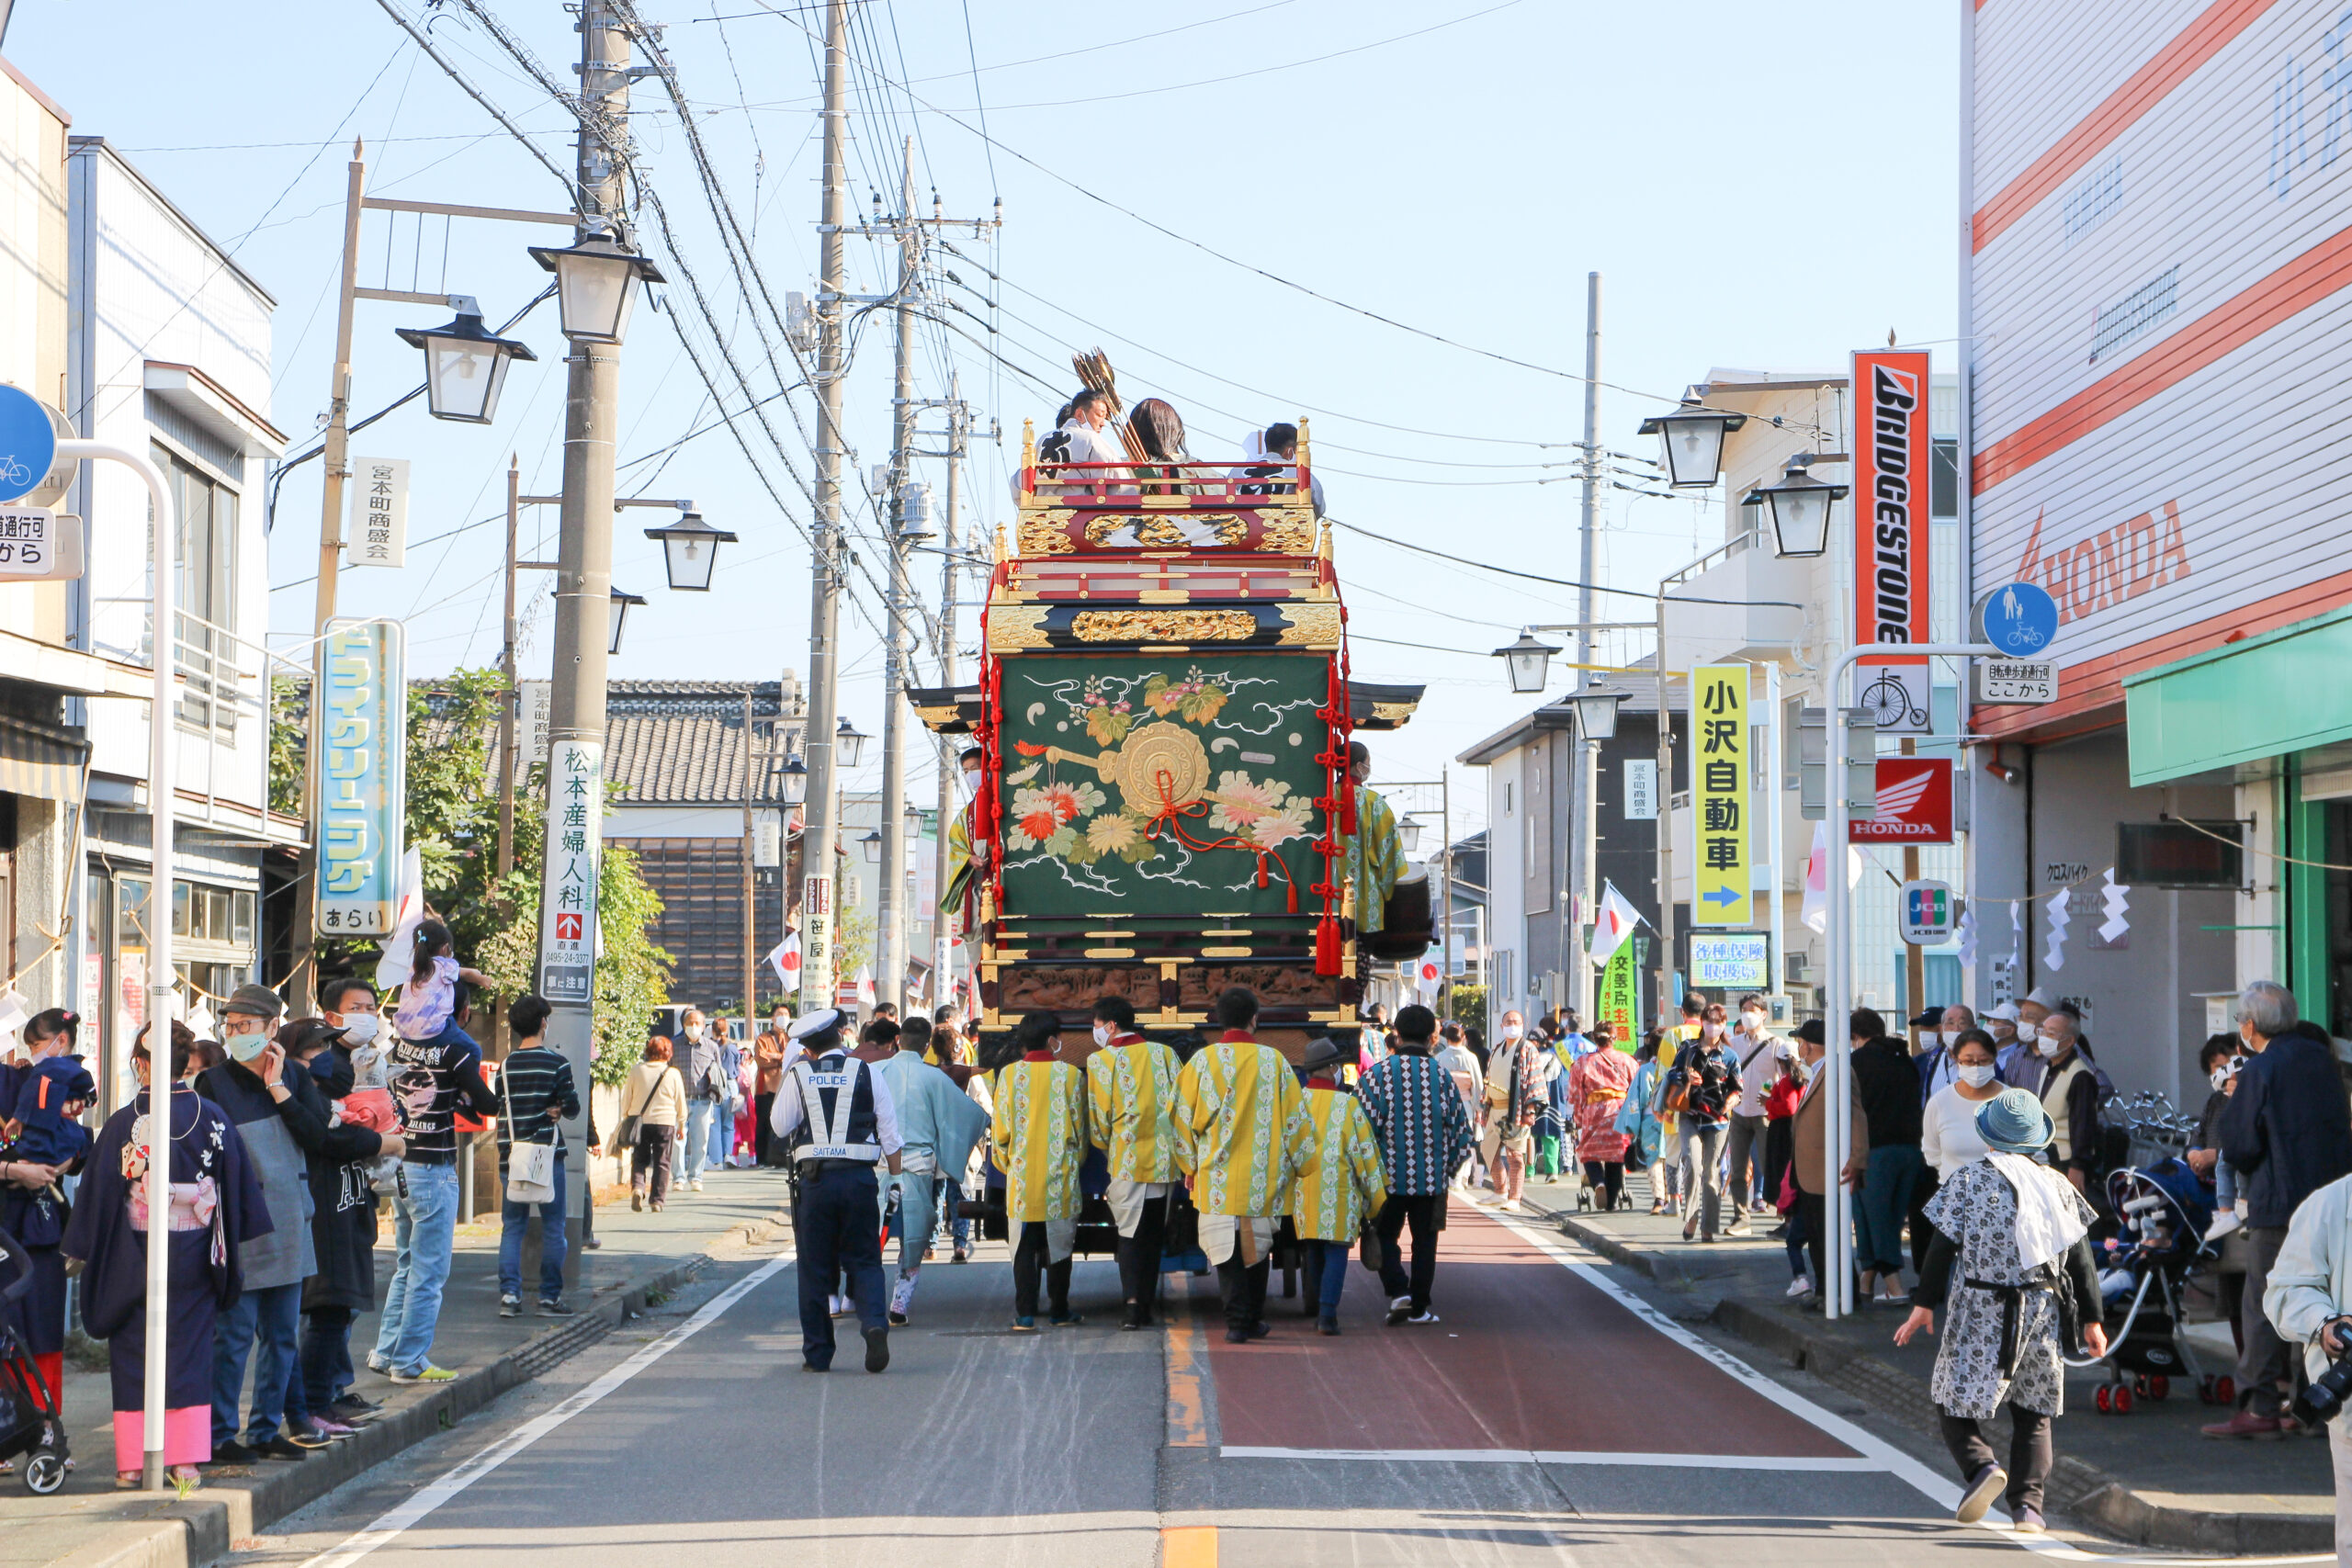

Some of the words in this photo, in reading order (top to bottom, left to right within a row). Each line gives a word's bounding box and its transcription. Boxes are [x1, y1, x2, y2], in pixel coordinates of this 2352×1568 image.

[367, 465, 393, 559] 宮本町商盛会
[1875, 366, 1915, 645] BRIDGESTONE
[2043, 499, 2191, 626] HONDA
[1989, 664, 2050, 679] 自転車歩道通行可
[1989, 682, 2049, 697] ここから
[327, 627, 372, 892] ドライクリーニング
[1703, 680, 1740, 872] 小沢自動車
[558, 747, 590, 910] 松本産婦人科
[1853, 823, 1937, 834] HONDA
[2047, 863, 2088, 882] クロスバイク
[1910, 903, 1945, 912] JCB
[326, 908, 383, 928] あらい
[557, 941, 580, 951] 直進
[1695, 942, 1765, 960] 各種保険
[546, 952, 589, 964] 0495-24-3377
[1703, 963, 1757, 979] 取扱い
[547, 976, 586, 989] 車に注意
[808, 1076, 847, 1086] POLICE
[813, 1147, 846, 1156] SAITAMA
